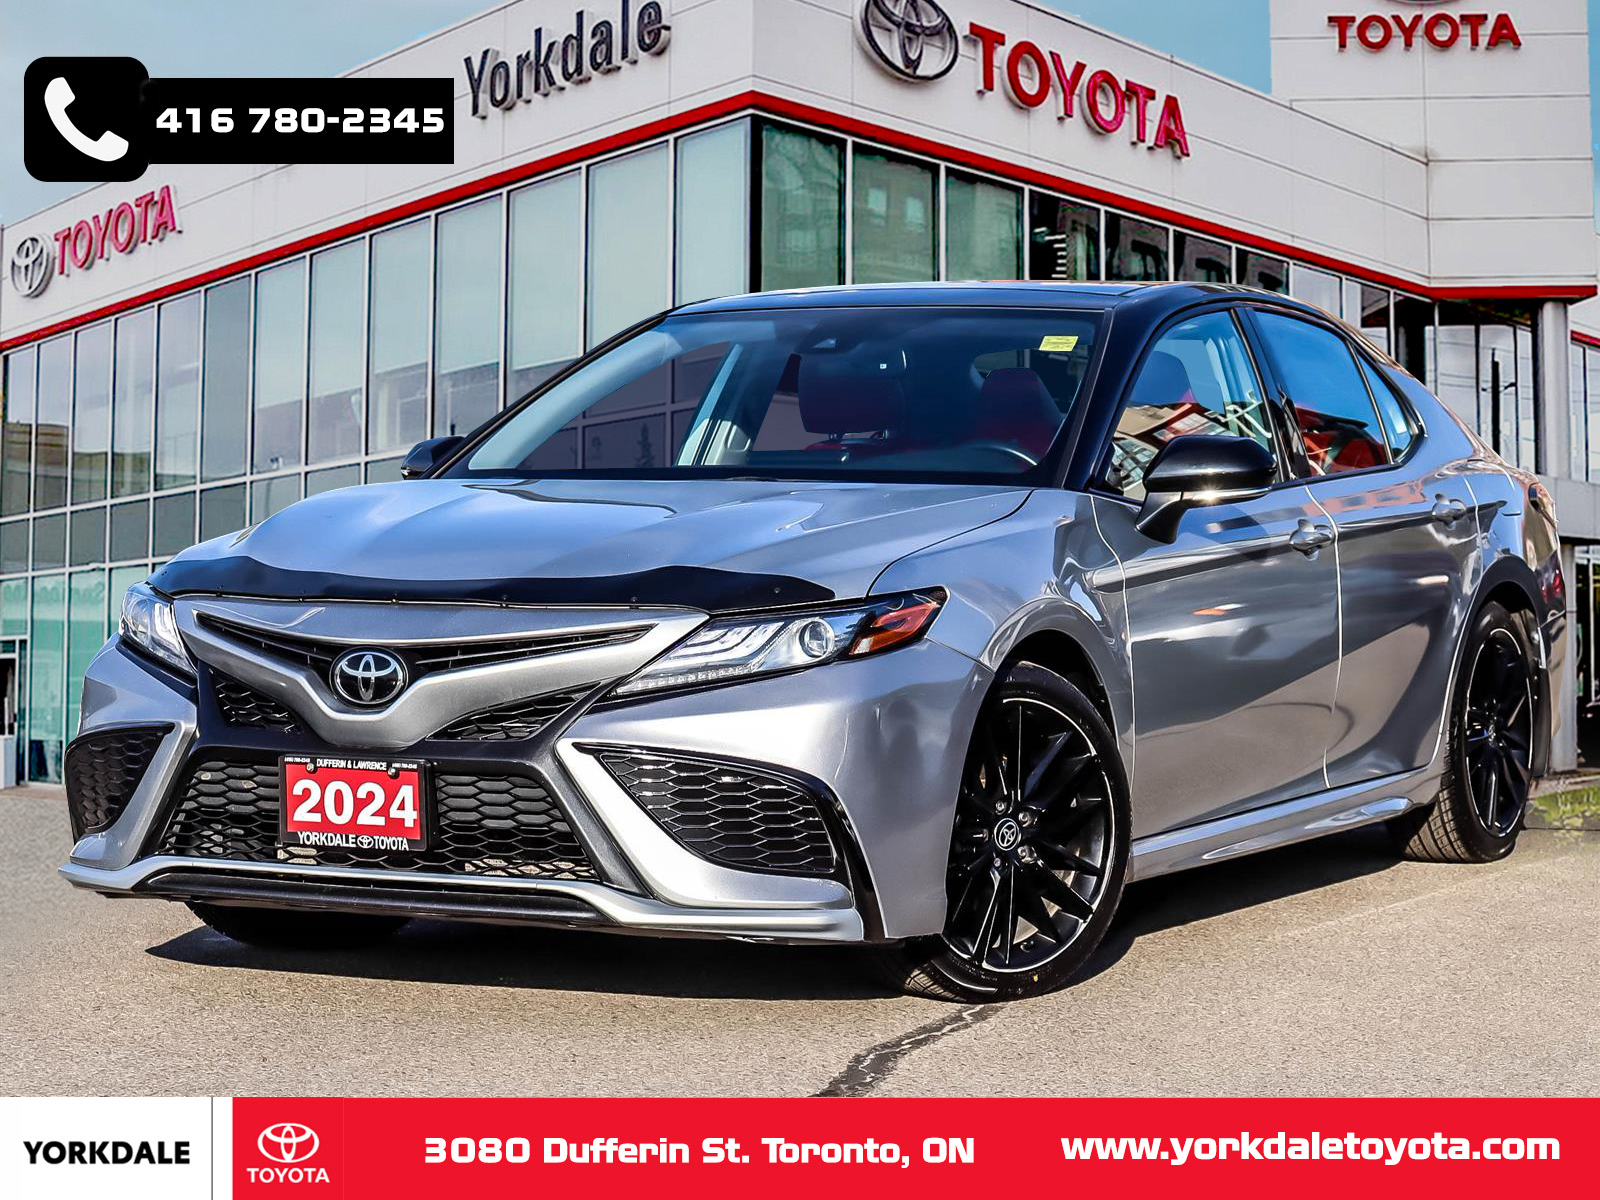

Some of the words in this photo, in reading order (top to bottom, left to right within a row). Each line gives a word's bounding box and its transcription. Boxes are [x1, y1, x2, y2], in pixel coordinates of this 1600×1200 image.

[1328, 12, 1522, 50] TOYOTA
[464, 0, 672, 119] Yorkdale
[969, 22, 1190, 158] TOYOTA
[54, 185, 181, 276] TOYOTA
[316, 758, 347, 768] DUFFERIN
[347, 760, 353, 769] &
[353, 760, 388, 771] LAWRENCE
[292, 778, 418, 828] 2024
[297, 831, 357, 848] YORKDALE
[373, 836, 410, 851] TOYOTA
